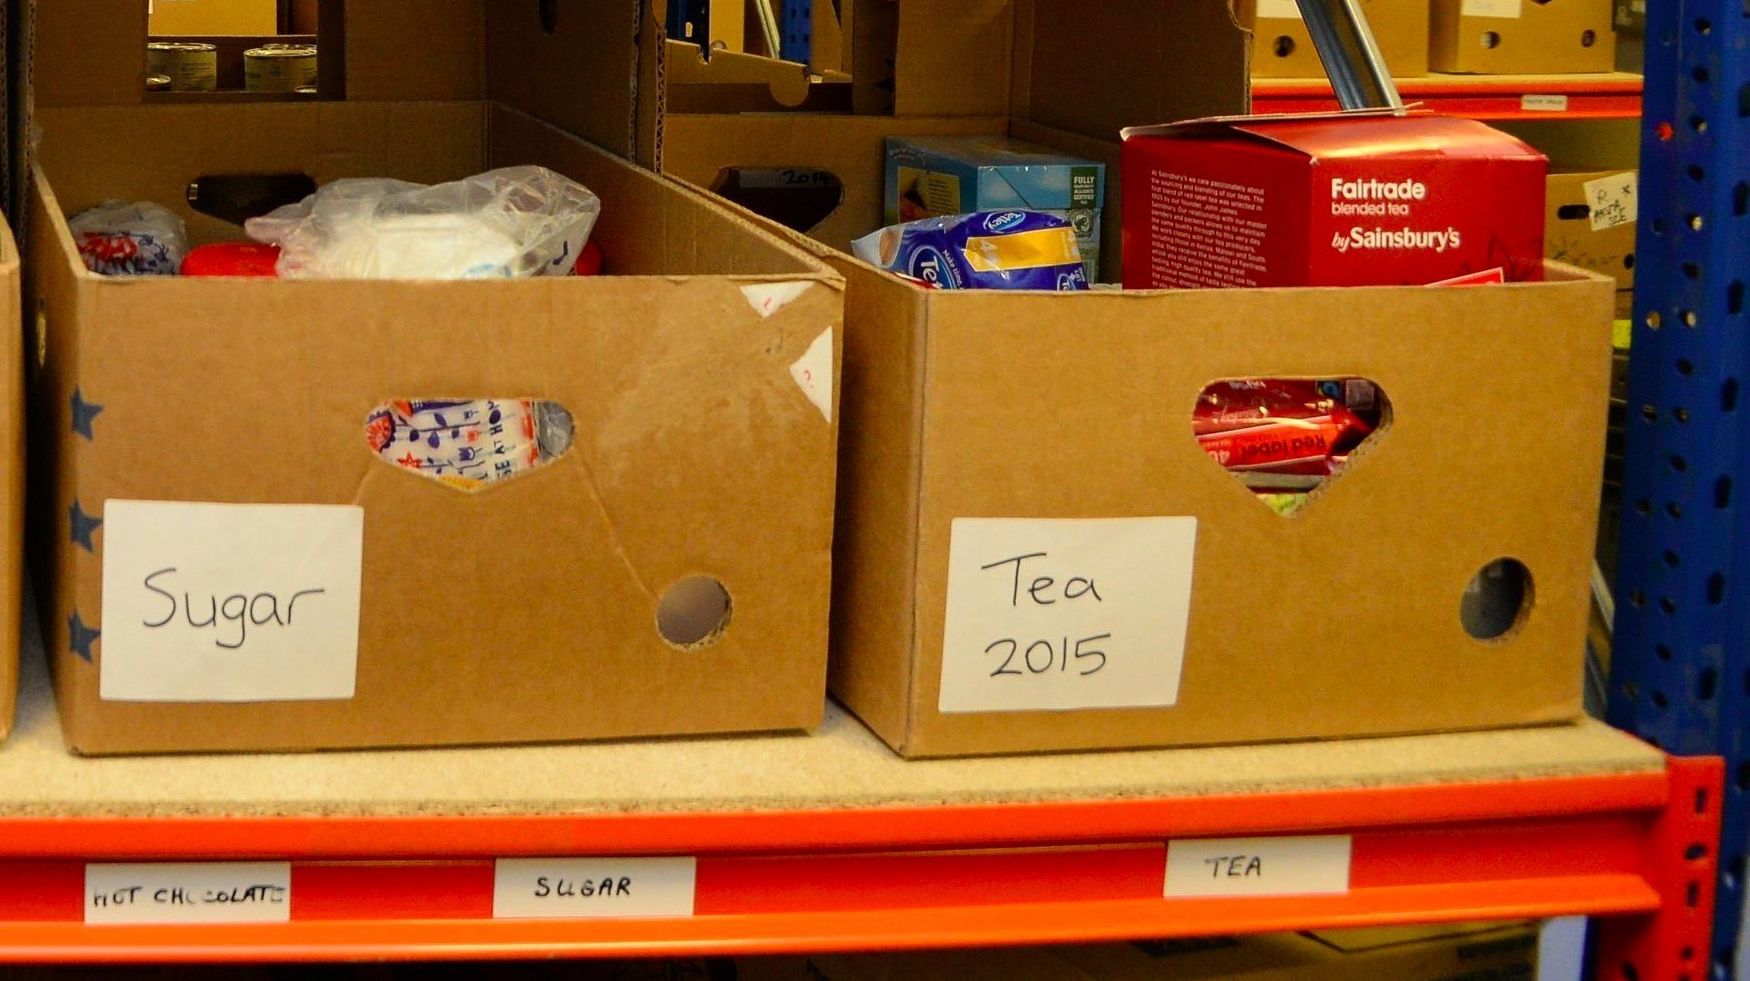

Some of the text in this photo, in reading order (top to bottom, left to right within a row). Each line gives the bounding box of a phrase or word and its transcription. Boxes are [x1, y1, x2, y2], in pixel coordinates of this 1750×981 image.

[1331, 178, 1426, 199] Fairtrade
[1331, 202, 1409, 215] blended tea
[1331, 226, 1461, 253] by Sainsbury's
[980, 552, 1103, 606] Tea
[142, 567, 326, 650] Sugar
[984, 631, 1112, 678] 2015
[1204, 855, 1262, 878] TEA
[534, 876, 632, 898] SUGAR
